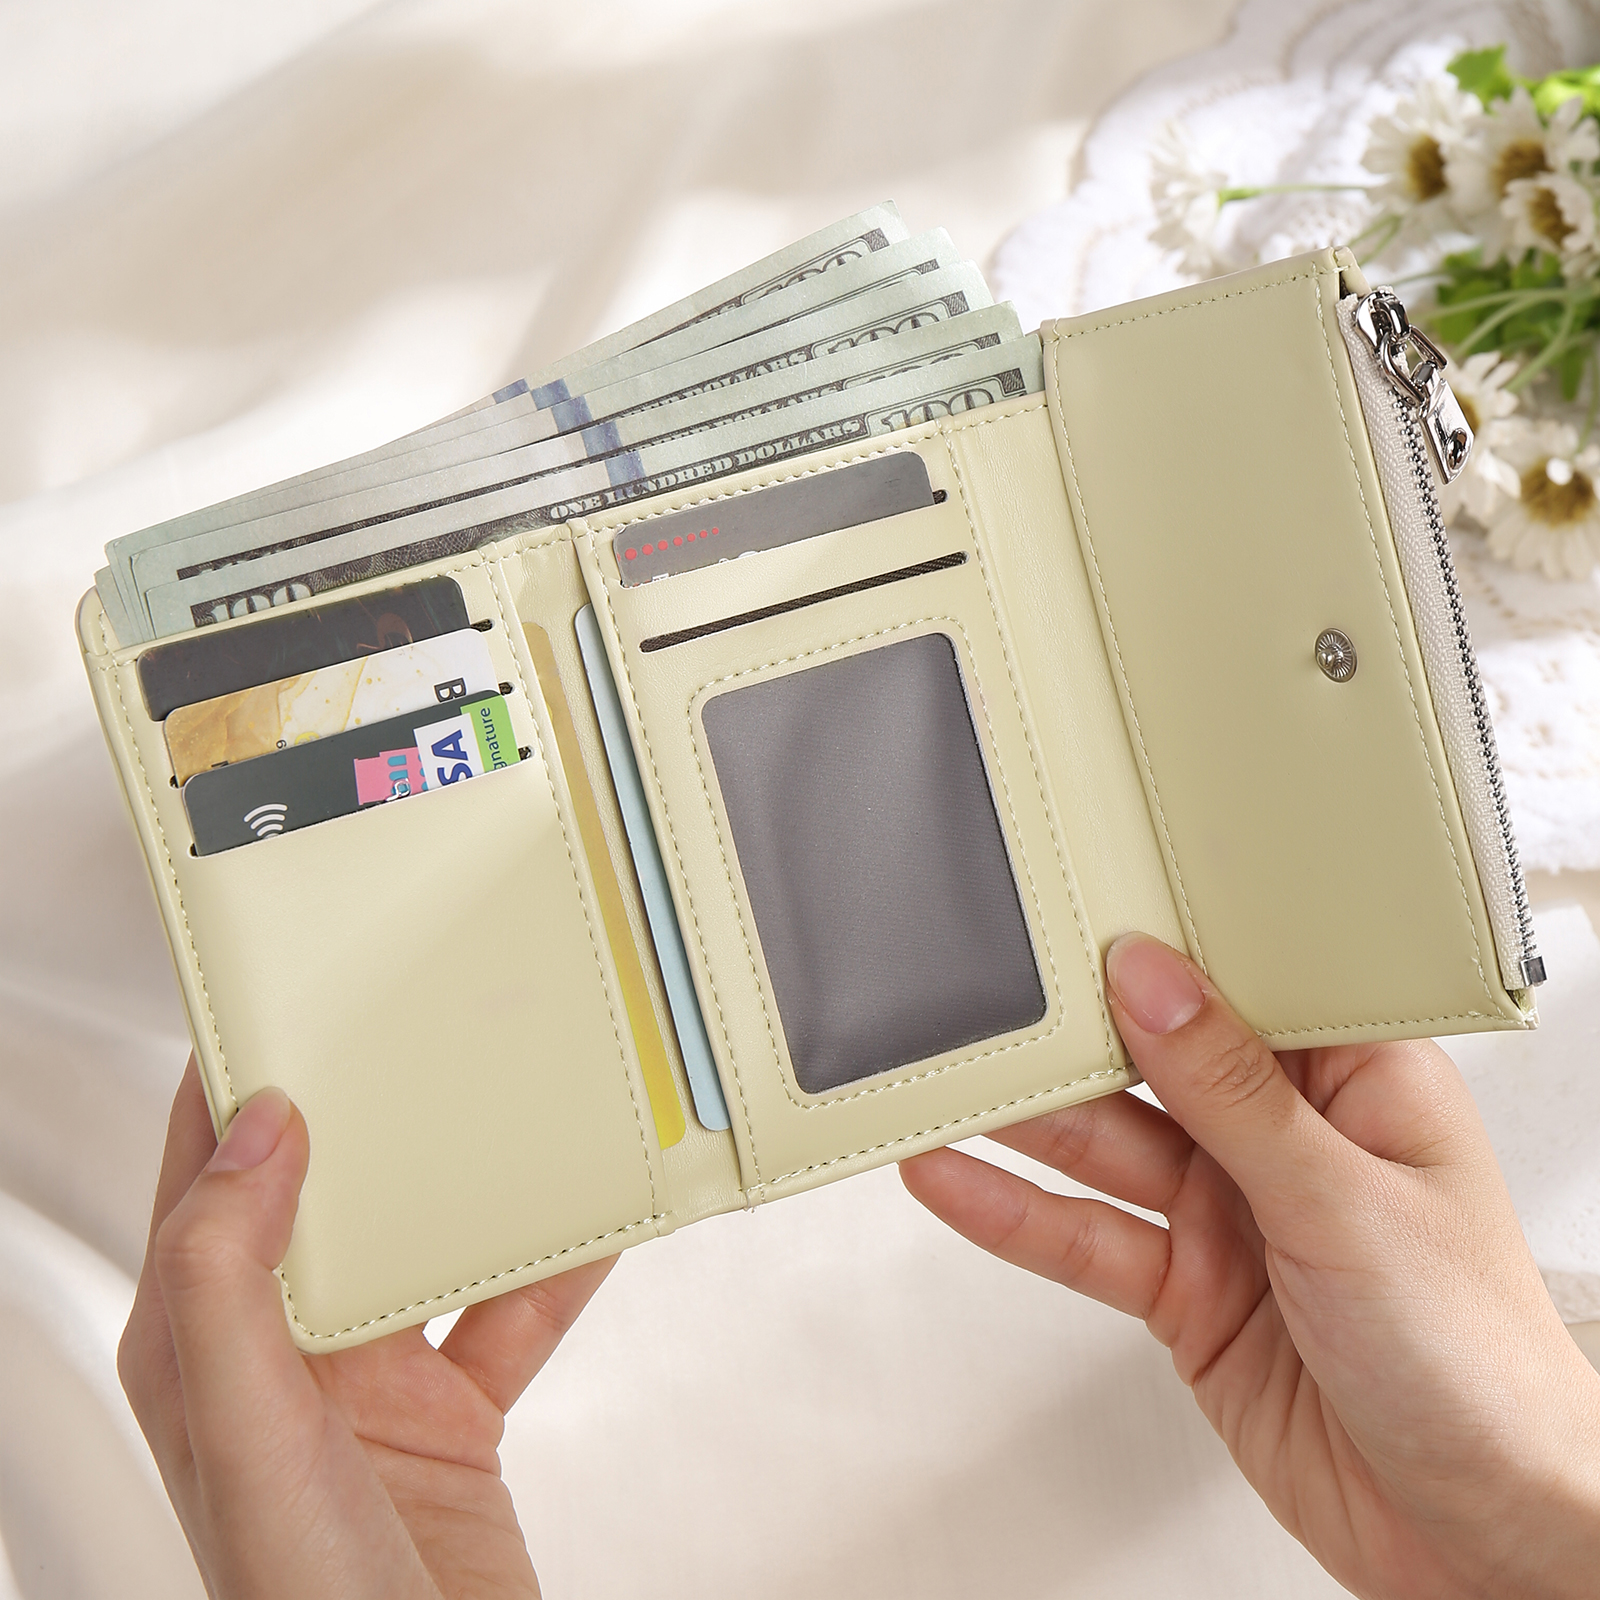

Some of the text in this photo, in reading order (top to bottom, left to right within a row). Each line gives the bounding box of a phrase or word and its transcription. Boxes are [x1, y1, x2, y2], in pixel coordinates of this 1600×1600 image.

[550, 495, 602, 520] ONE
[606, 455, 733, 505] HUNDRED
[739, 418, 861, 465] DOLLARS
[434, 677, 467, 702] B
